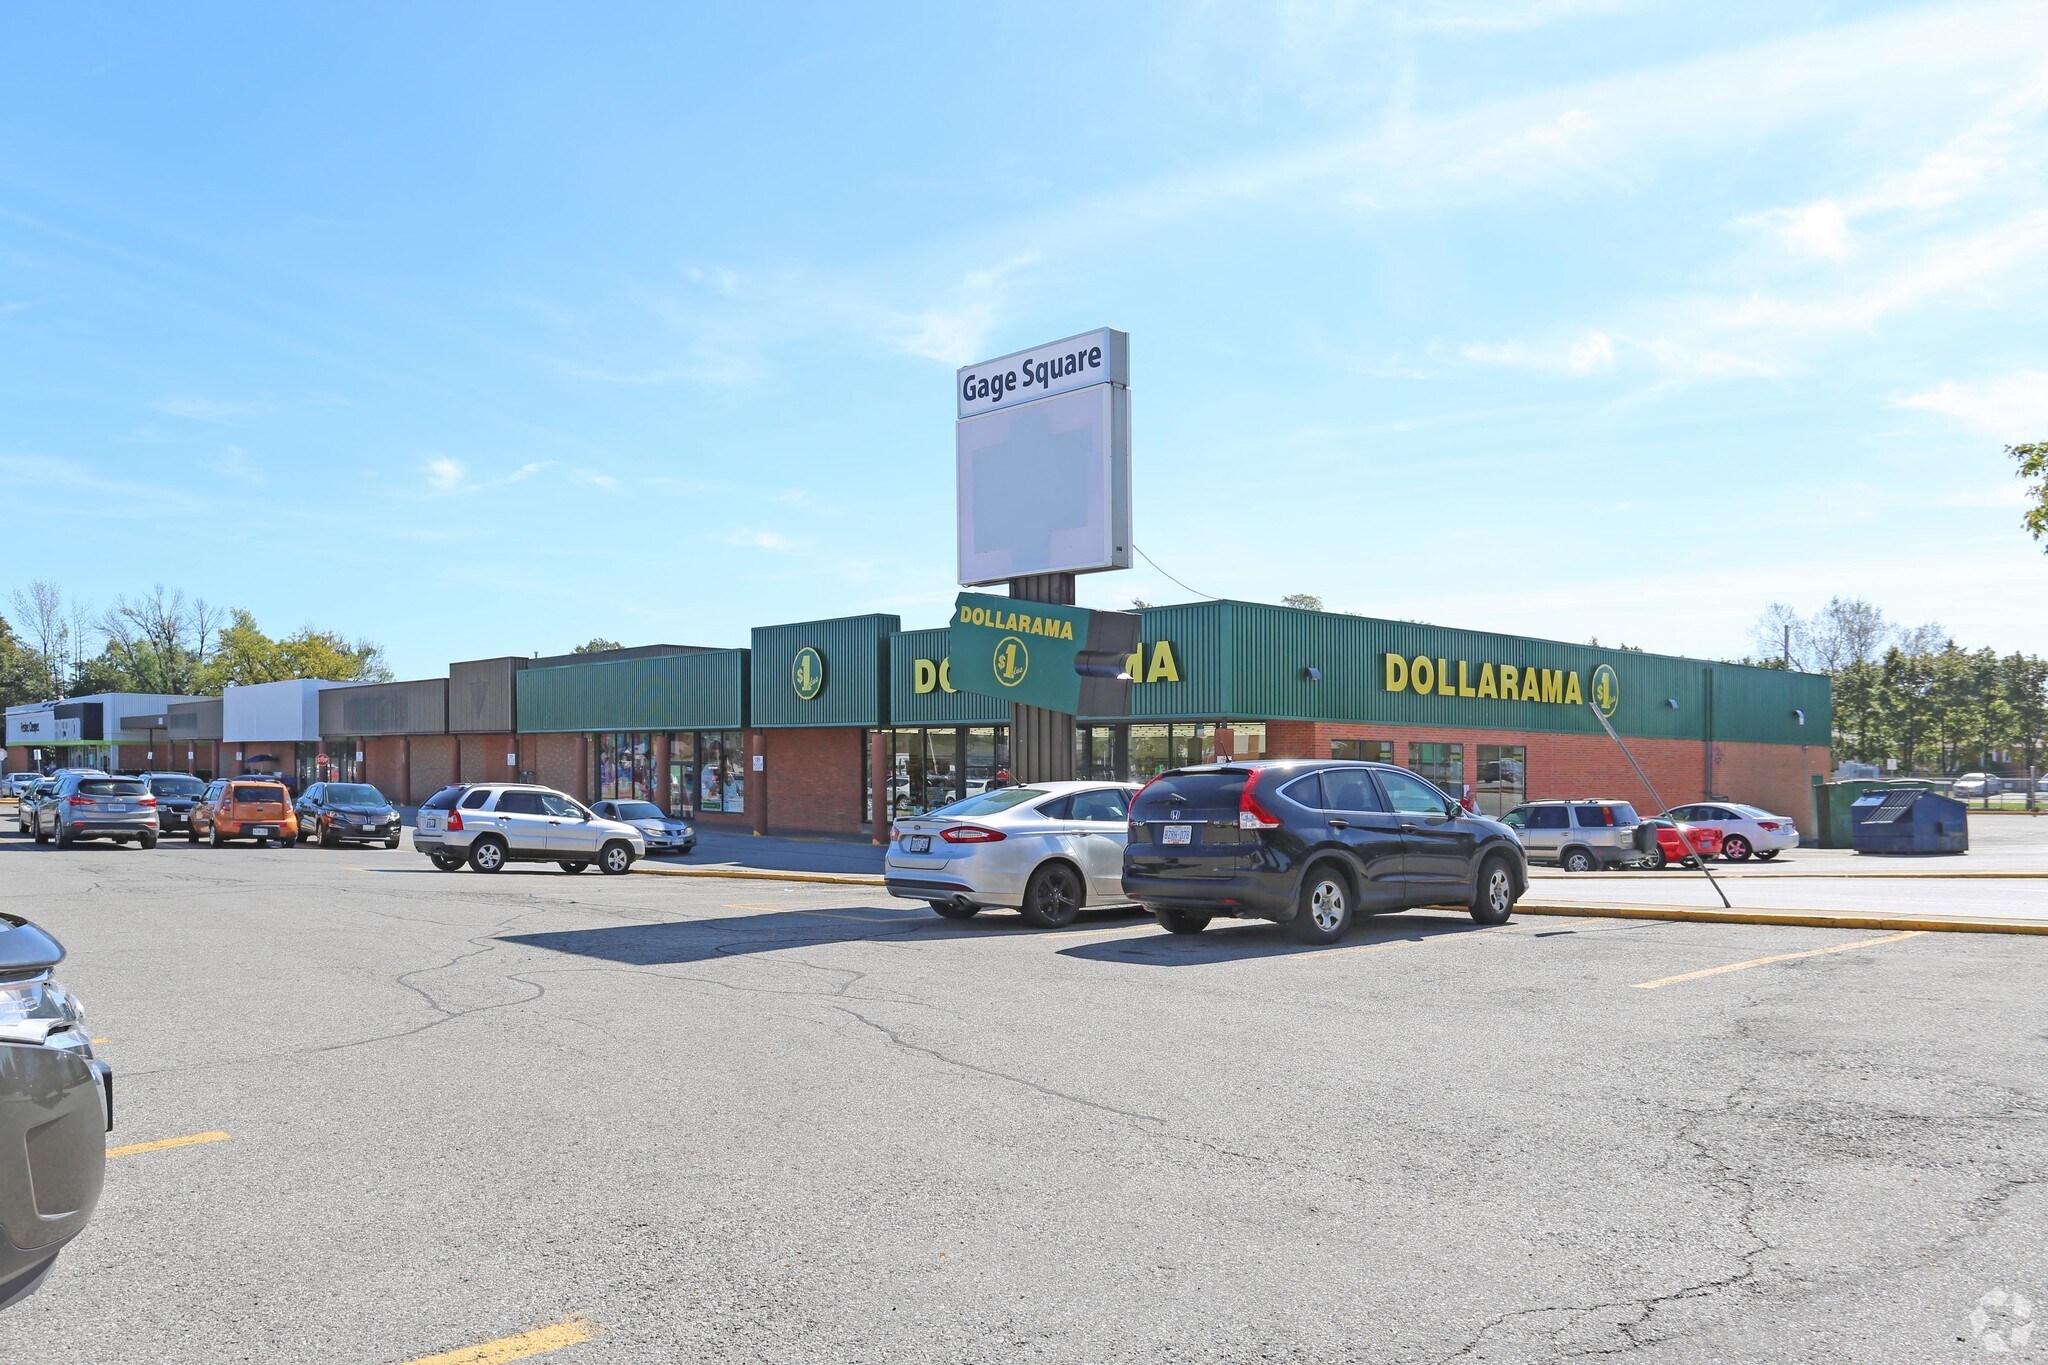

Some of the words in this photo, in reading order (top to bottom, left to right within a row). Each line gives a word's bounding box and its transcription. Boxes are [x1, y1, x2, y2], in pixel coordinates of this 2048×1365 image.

[963, 370, 1017, 402] Gage
[1022, 346, 1102, 389] Square
[960, 605, 1074, 641] DOLLARAMA
[1385, 653, 1583, 705] DOLLARAMA
